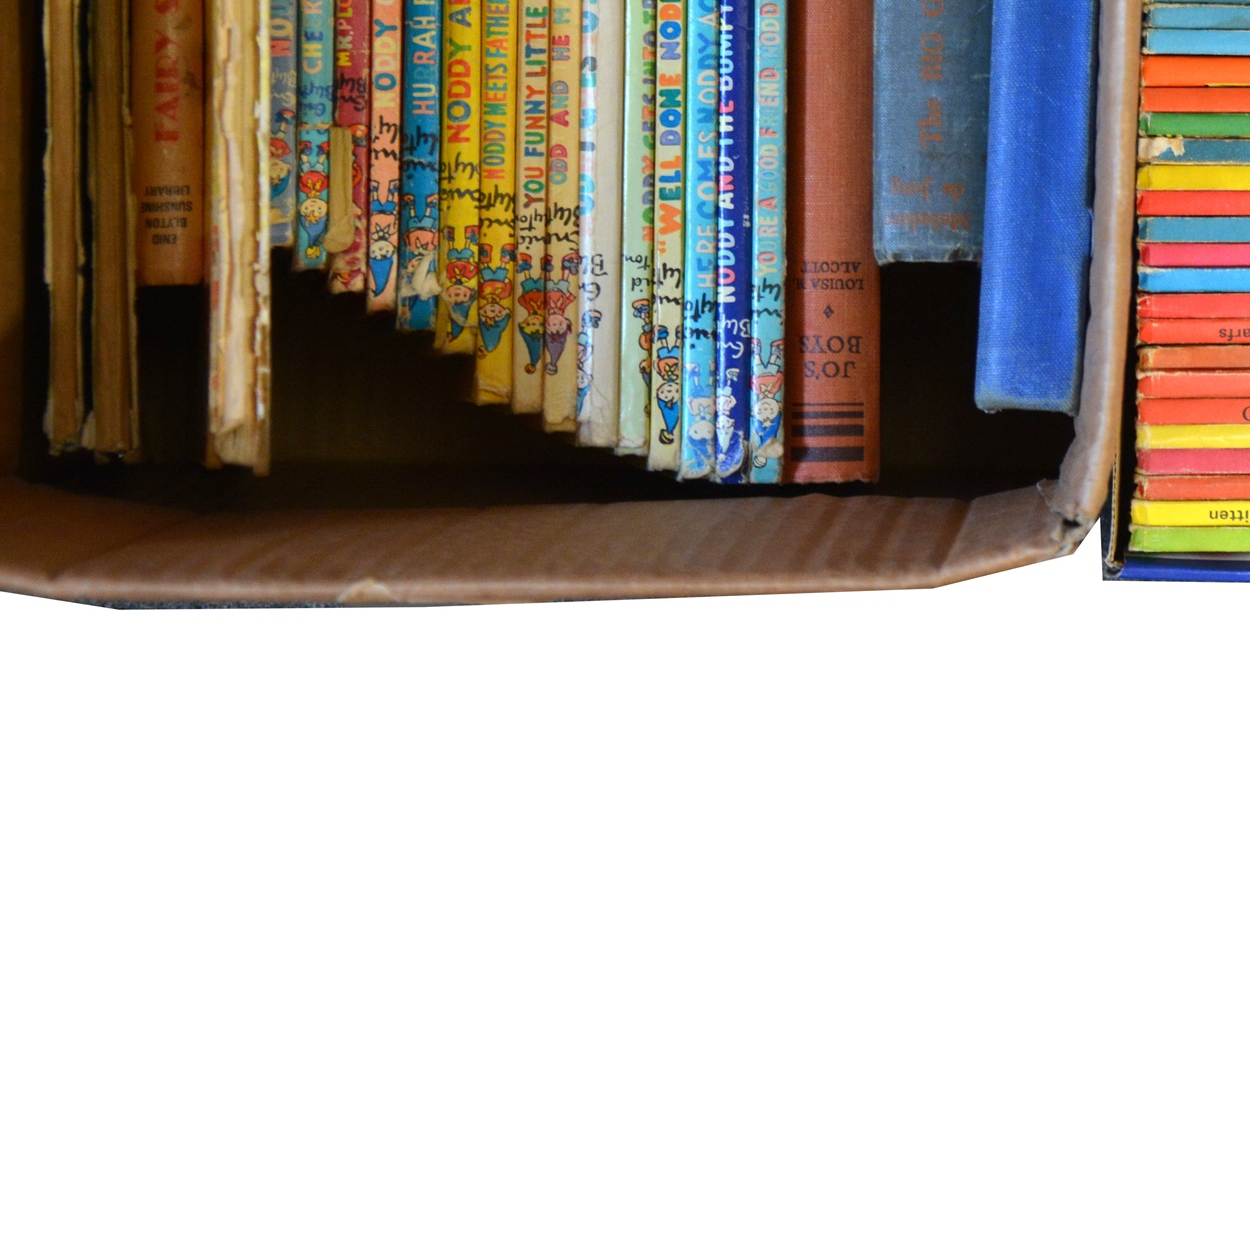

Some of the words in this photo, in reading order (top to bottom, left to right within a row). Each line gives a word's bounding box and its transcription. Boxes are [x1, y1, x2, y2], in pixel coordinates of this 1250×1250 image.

[375, 19, 397, 108] NODDY
[526, 6, 546, 77] LITTLE
[448, 40, 471, 143] NODDY
[484, 64, 508, 116] MEETS
[524, 85, 545, 158] FUNNY
[659, 74, 682, 146] DONE
[483, 121, 506, 180] NODDY
[524, 167, 545, 209] YOU
[798, 335, 862, 354] BOYS
[803, 361, 856, 380] JO'S
